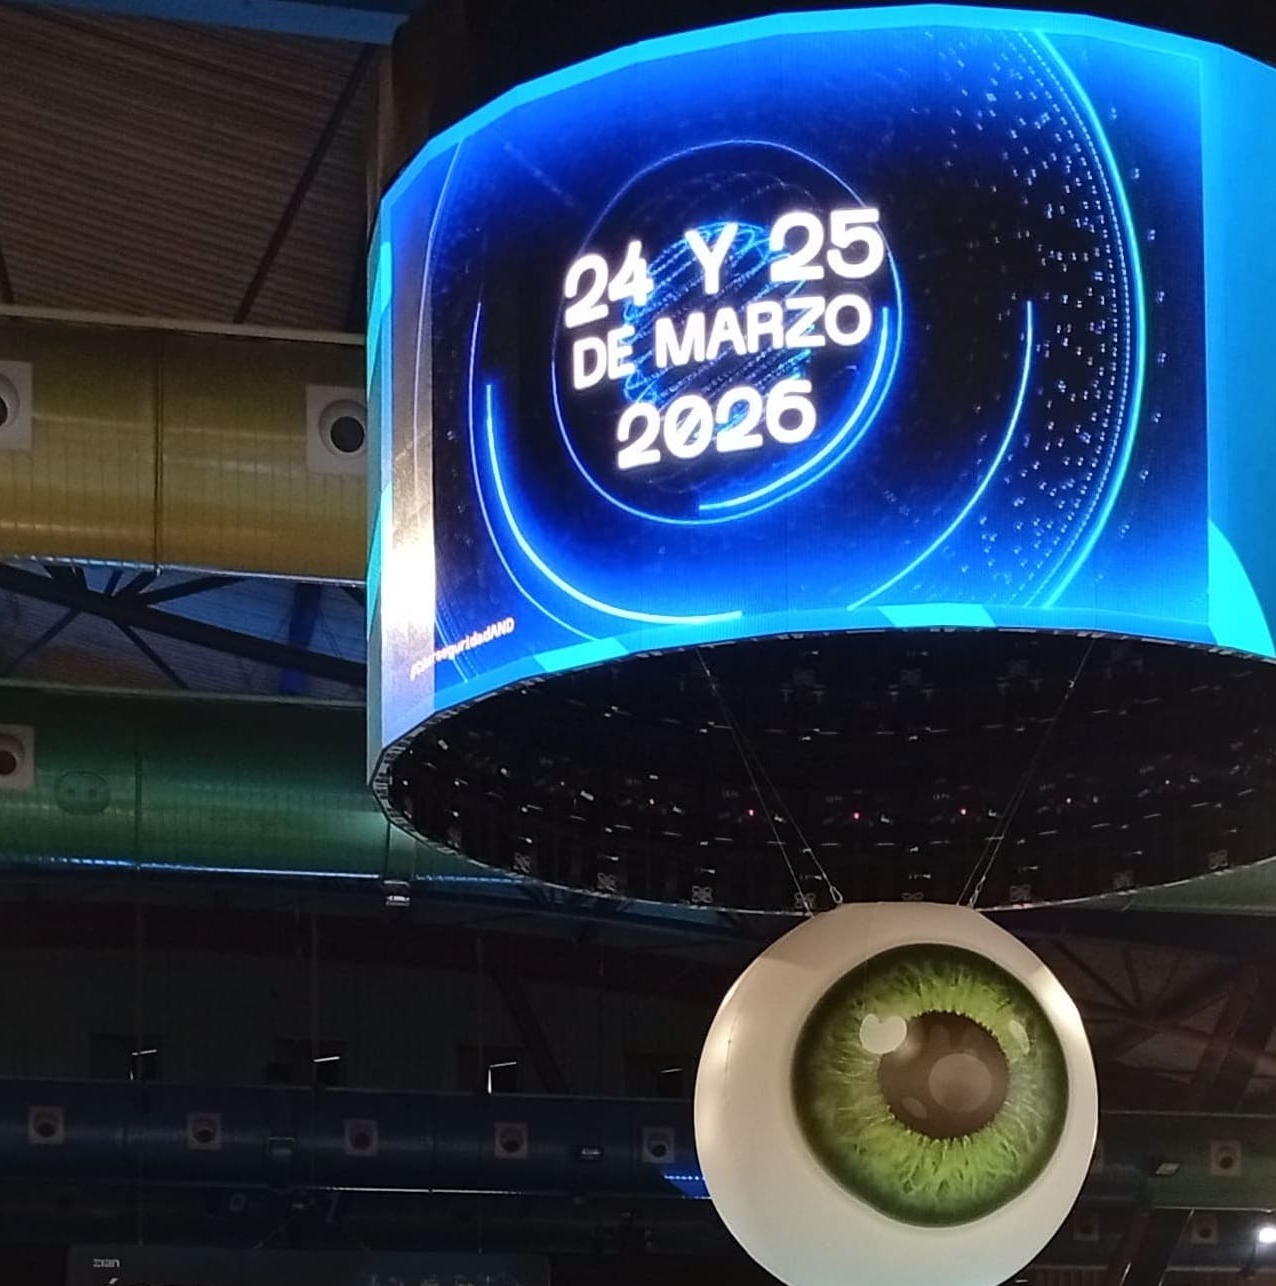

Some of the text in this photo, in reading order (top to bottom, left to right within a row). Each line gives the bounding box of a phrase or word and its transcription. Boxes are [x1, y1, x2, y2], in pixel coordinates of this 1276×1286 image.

[564, 207, 886, 329] 24 Y 25
[573, 292, 873, 391] DE MARZO
[617, 378, 818, 471] 2026
